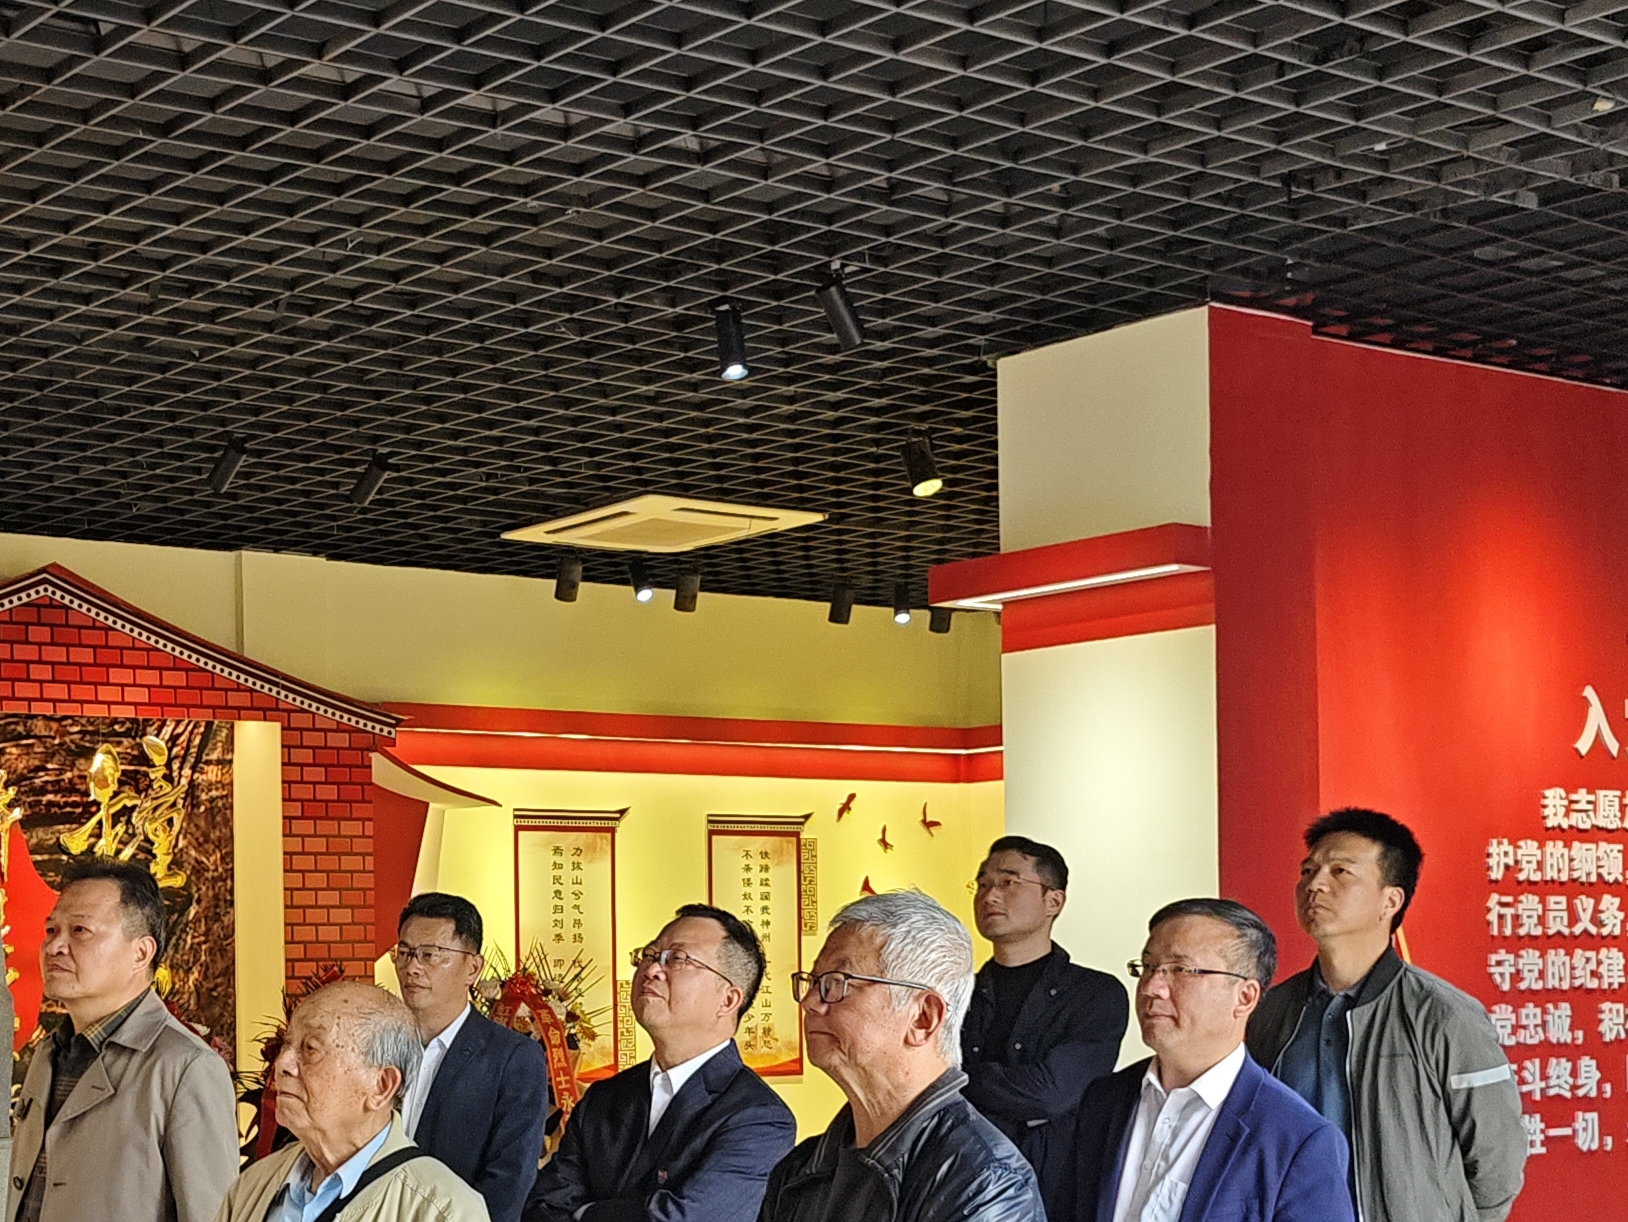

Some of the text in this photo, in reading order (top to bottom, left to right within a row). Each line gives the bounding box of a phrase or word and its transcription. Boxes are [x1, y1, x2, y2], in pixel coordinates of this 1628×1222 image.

[1573, 684, 1628, 760] 入
[1540, 786, 1628, 830] 我志愿
[1485, 838, 1624, 884] 护党的纲领
[741, 849, 753, 924] 不杀倭奴不
[1485, 893, 1625, 937] 行党员义务
[1487, 947, 1626, 991] 守党的纪律
[1489, 1002, 1628, 1046] 党忠诚，积
[538, 1008, 575, 1116] 革命烈士永
[1508, 1055, 1628, 1101] 斗终身，
[1520, 1111, 1628, 1157] 牲一切，
